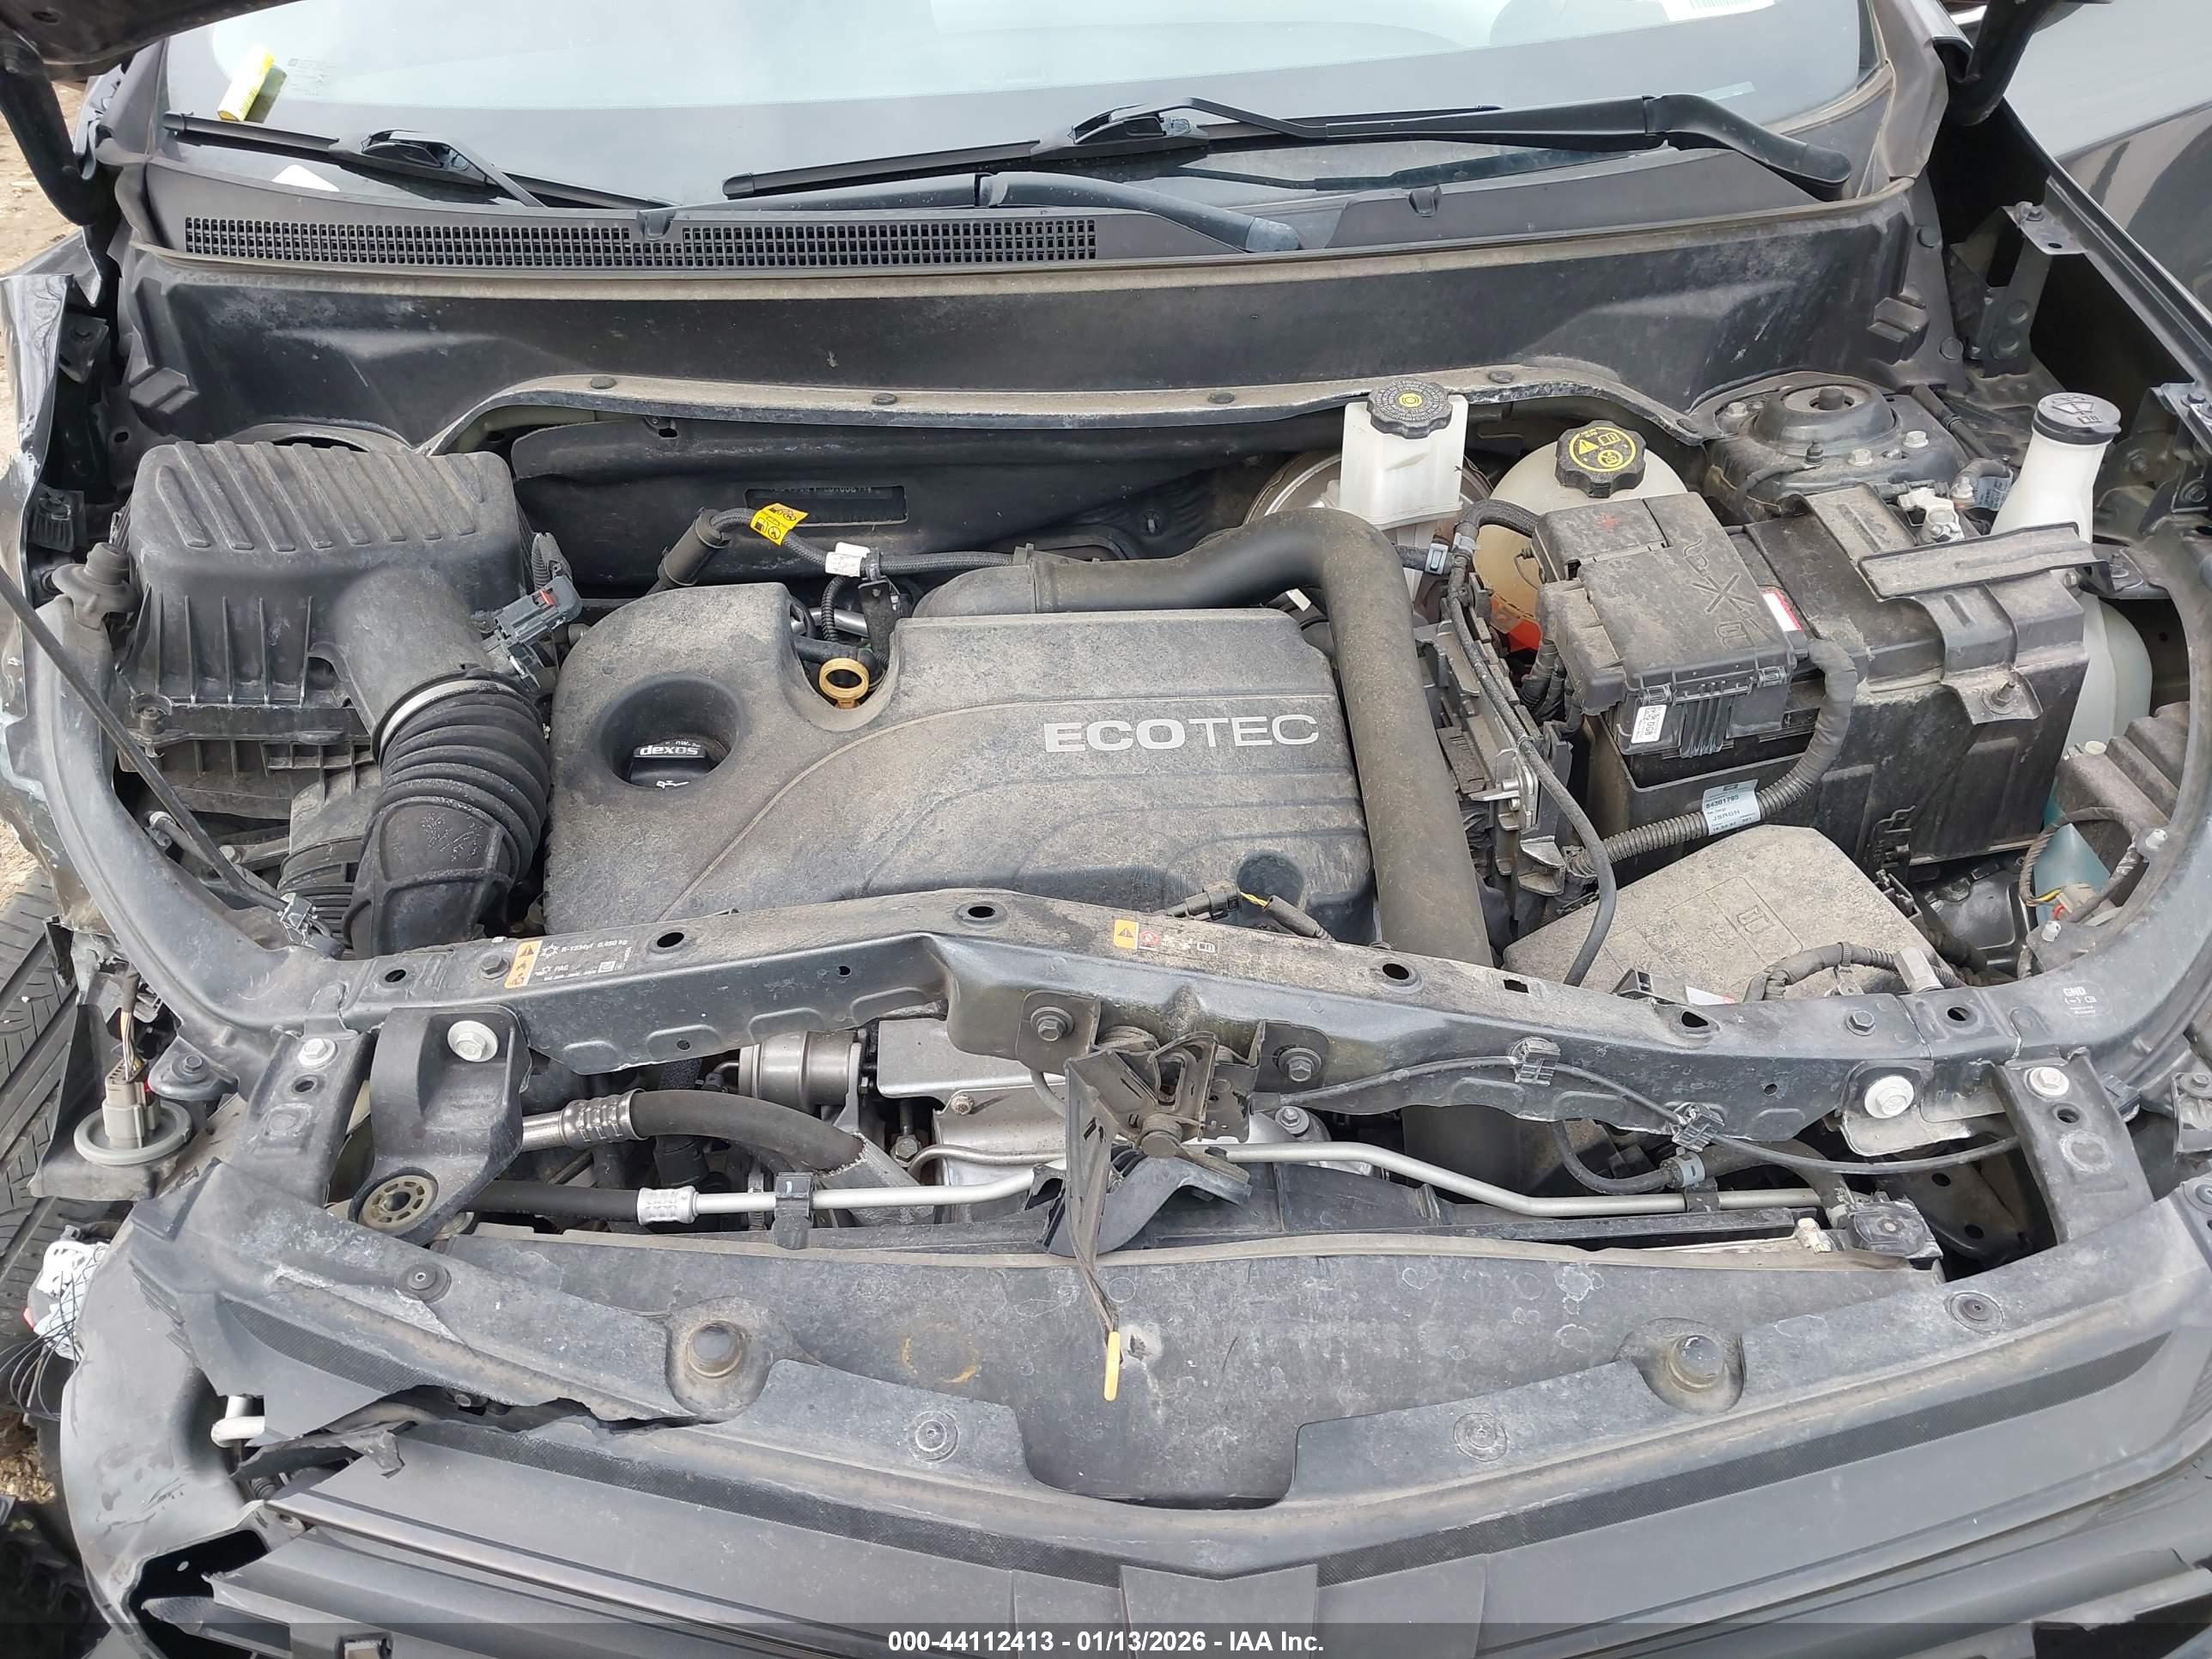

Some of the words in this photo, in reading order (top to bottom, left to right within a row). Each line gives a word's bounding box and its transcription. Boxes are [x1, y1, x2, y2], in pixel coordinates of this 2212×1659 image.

[1043, 714, 1319, 752] ECOTEC
[640, 744, 702, 756] dexos
[2063, 986, 2087, 997] GND
